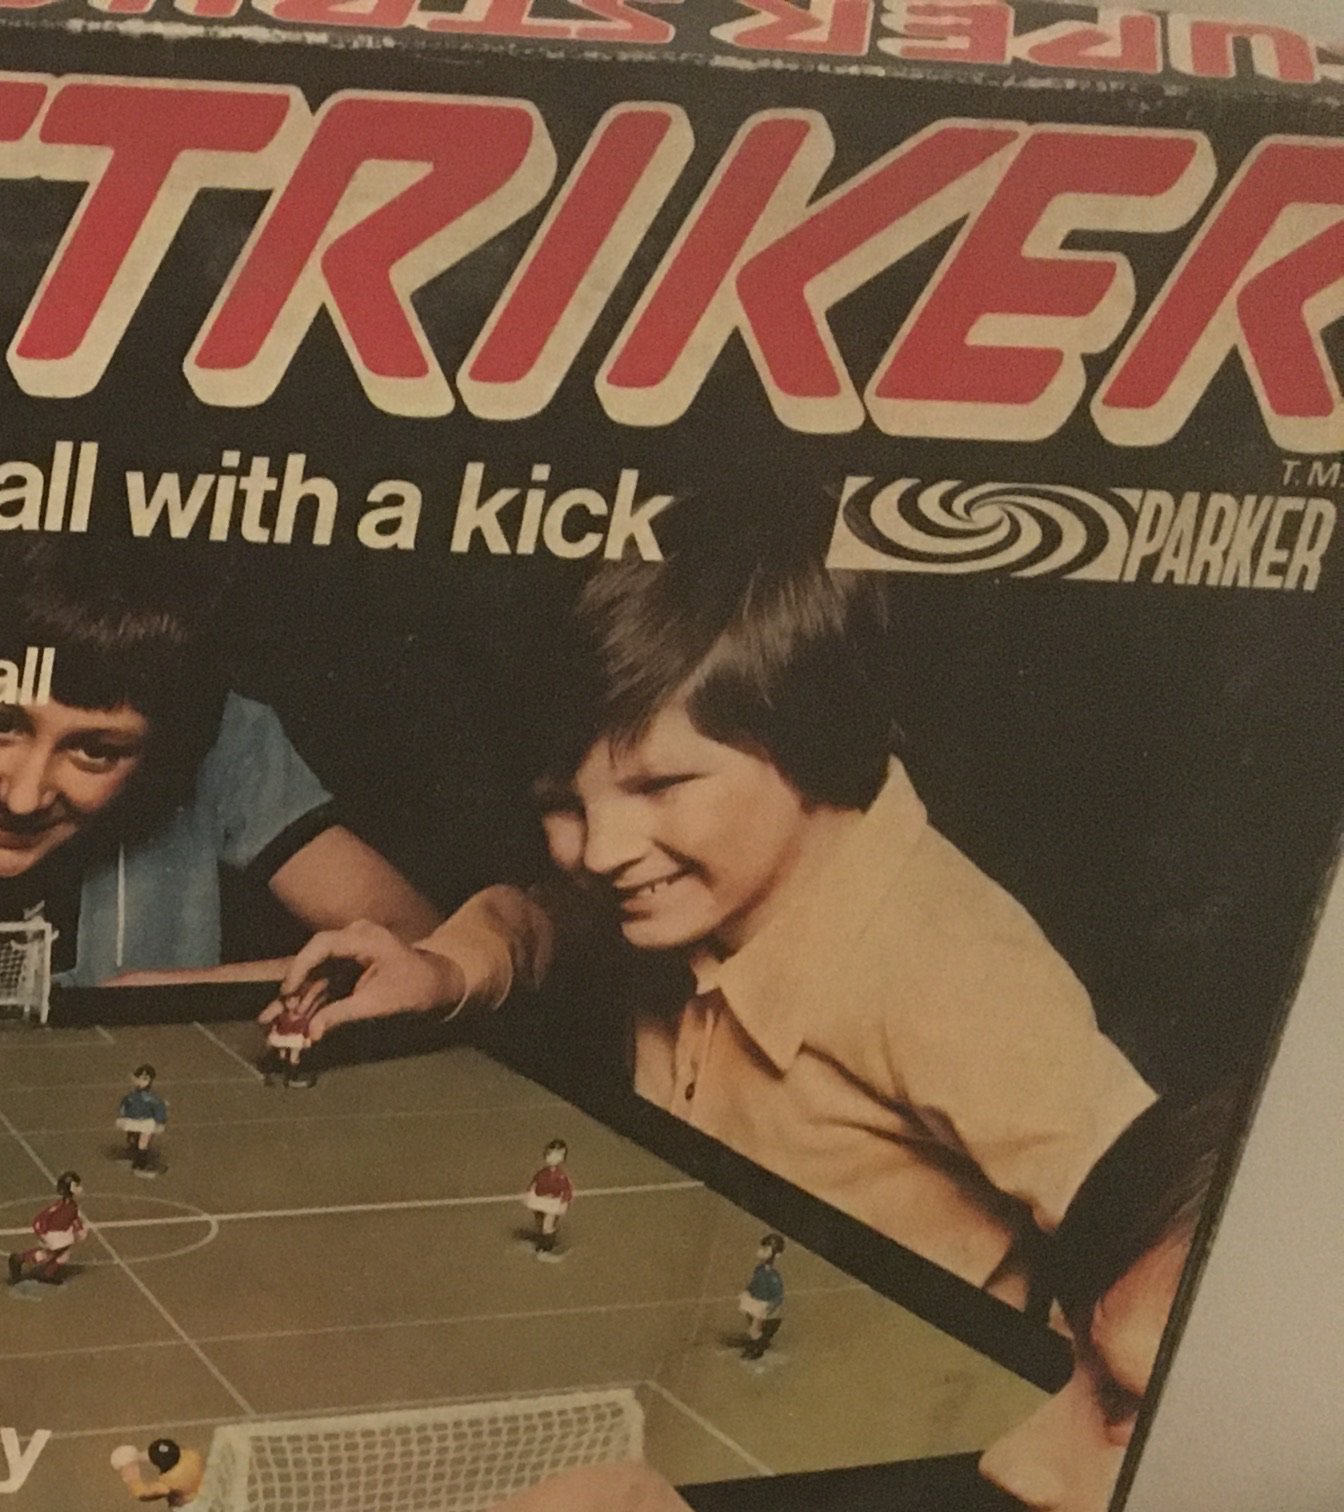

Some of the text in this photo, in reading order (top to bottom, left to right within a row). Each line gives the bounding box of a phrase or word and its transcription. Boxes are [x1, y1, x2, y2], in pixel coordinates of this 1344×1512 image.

[709, 0, 1344, 84] UPER
[124, 449, 340, 547] with
[356, 479, 422, 551] a
[448, 461, 678, 562] kick
[1120, 488, 1338, 592] PARKER
